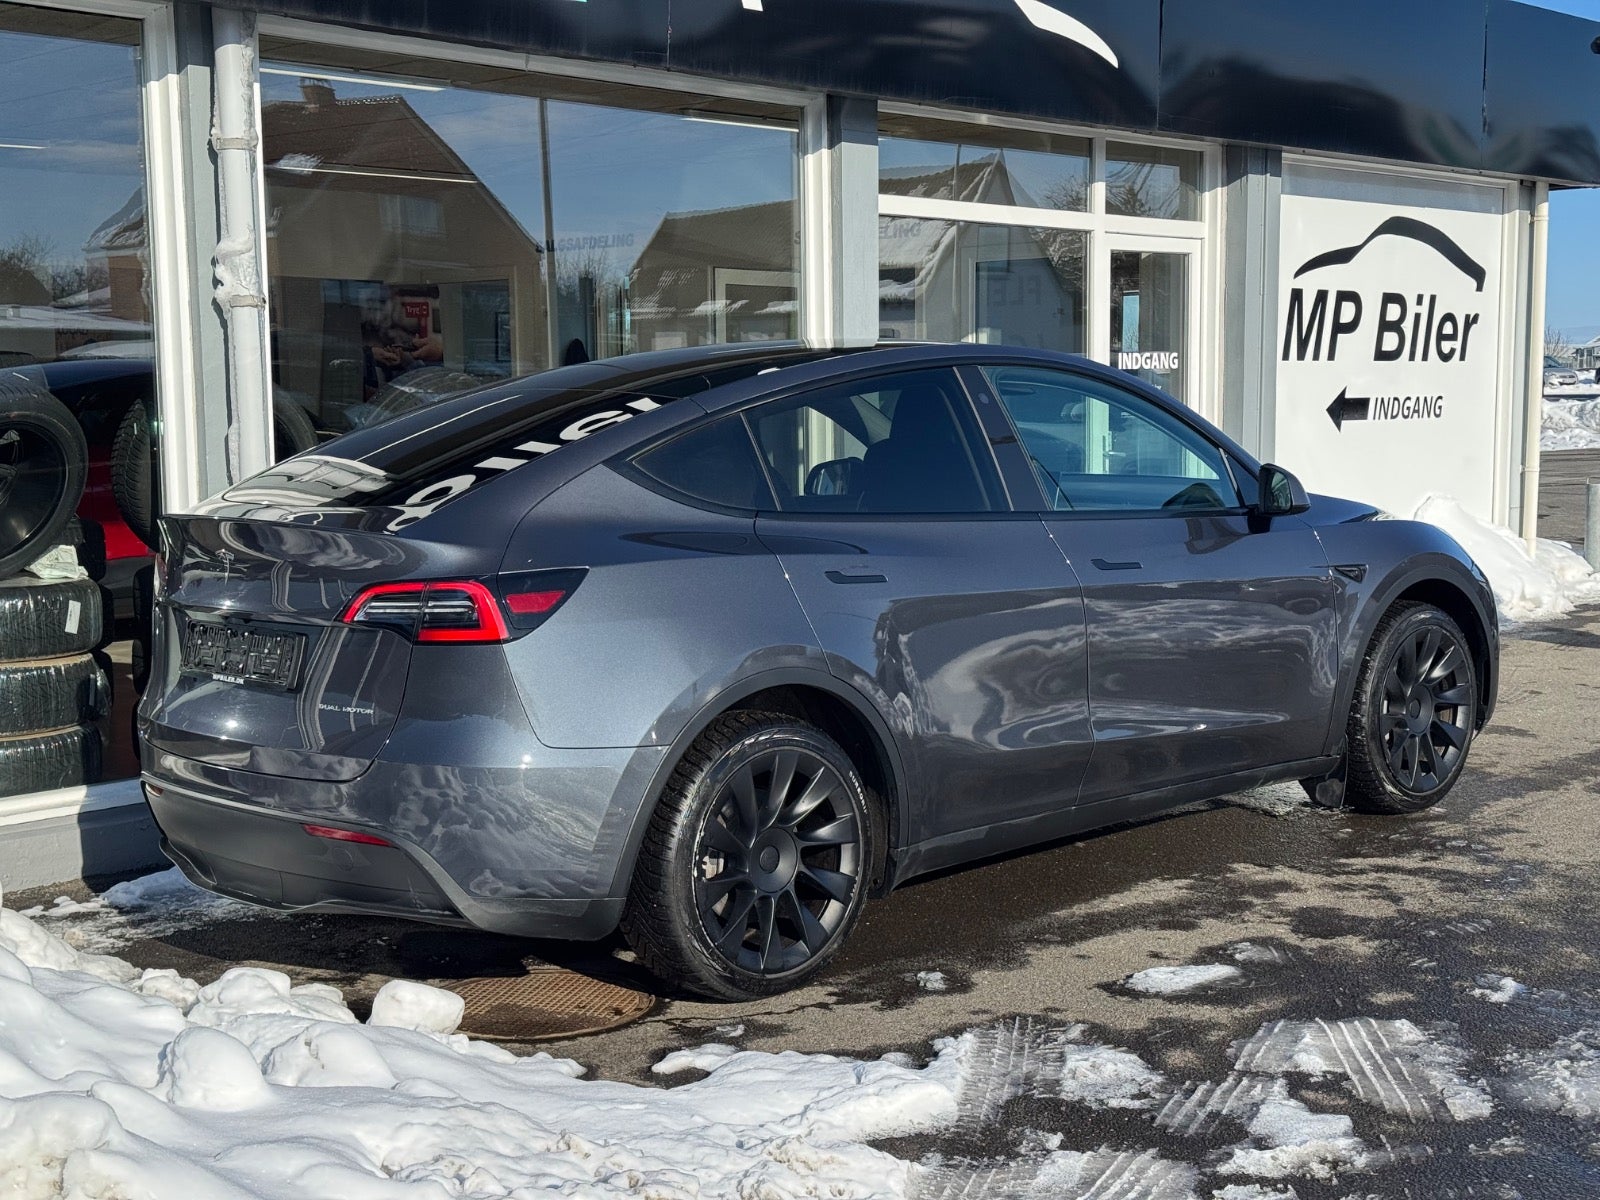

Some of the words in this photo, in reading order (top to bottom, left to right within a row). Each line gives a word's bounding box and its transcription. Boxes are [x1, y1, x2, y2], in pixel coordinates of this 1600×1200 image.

[1281, 287, 1363, 362] MP
[1373, 292, 1480, 363] Biler
[1118, 352, 1179, 370] INDGANG
[1372, 395, 1444, 420] INDGANG
[318, 703, 341, 712] DUAL
[342, 706, 374, 715] MOTOR
